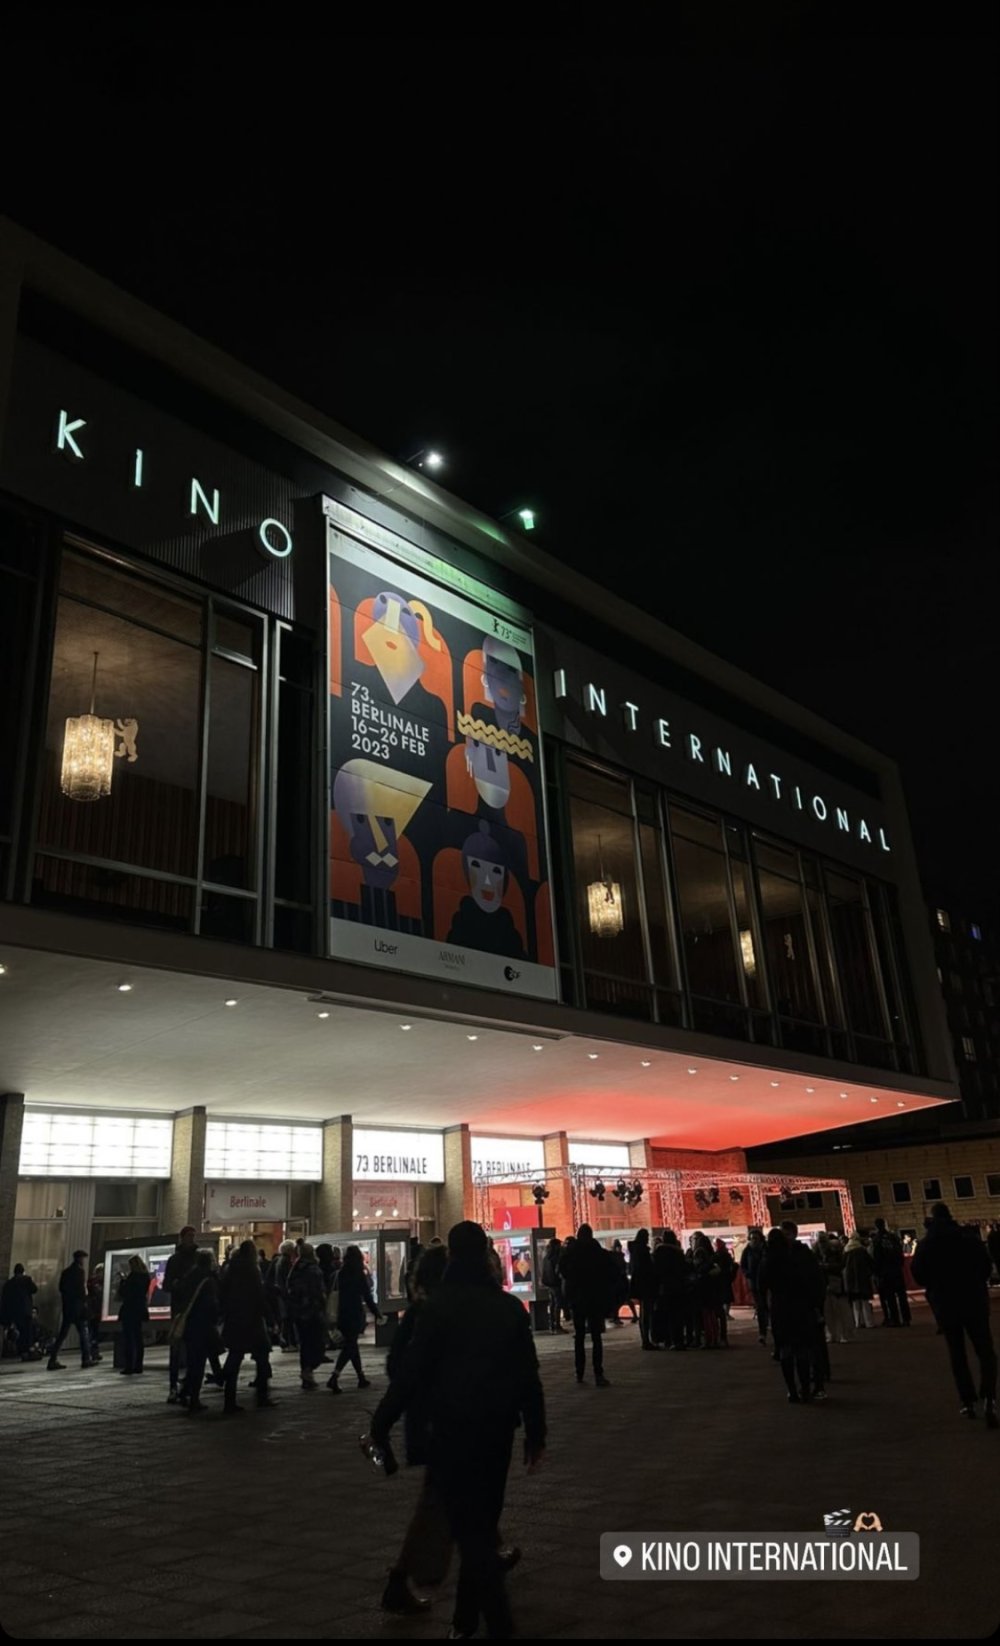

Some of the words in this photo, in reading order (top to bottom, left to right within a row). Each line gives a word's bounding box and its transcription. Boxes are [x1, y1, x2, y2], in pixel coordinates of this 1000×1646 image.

[57, 410, 293, 558] KINO
[351, 681, 375, 704] 73.
[351, 698, 430, 742] BERLINALE
[351, 733, 390, 759] 2023
[401, 735, 426, 756] FEB
[554, 668, 891, 852] INTERNATIONAL
[374, 939, 399, 955] Uber
[373, 1155, 427, 1174] BERLINALE
[229, 1195, 267, 1208] Berlinale
